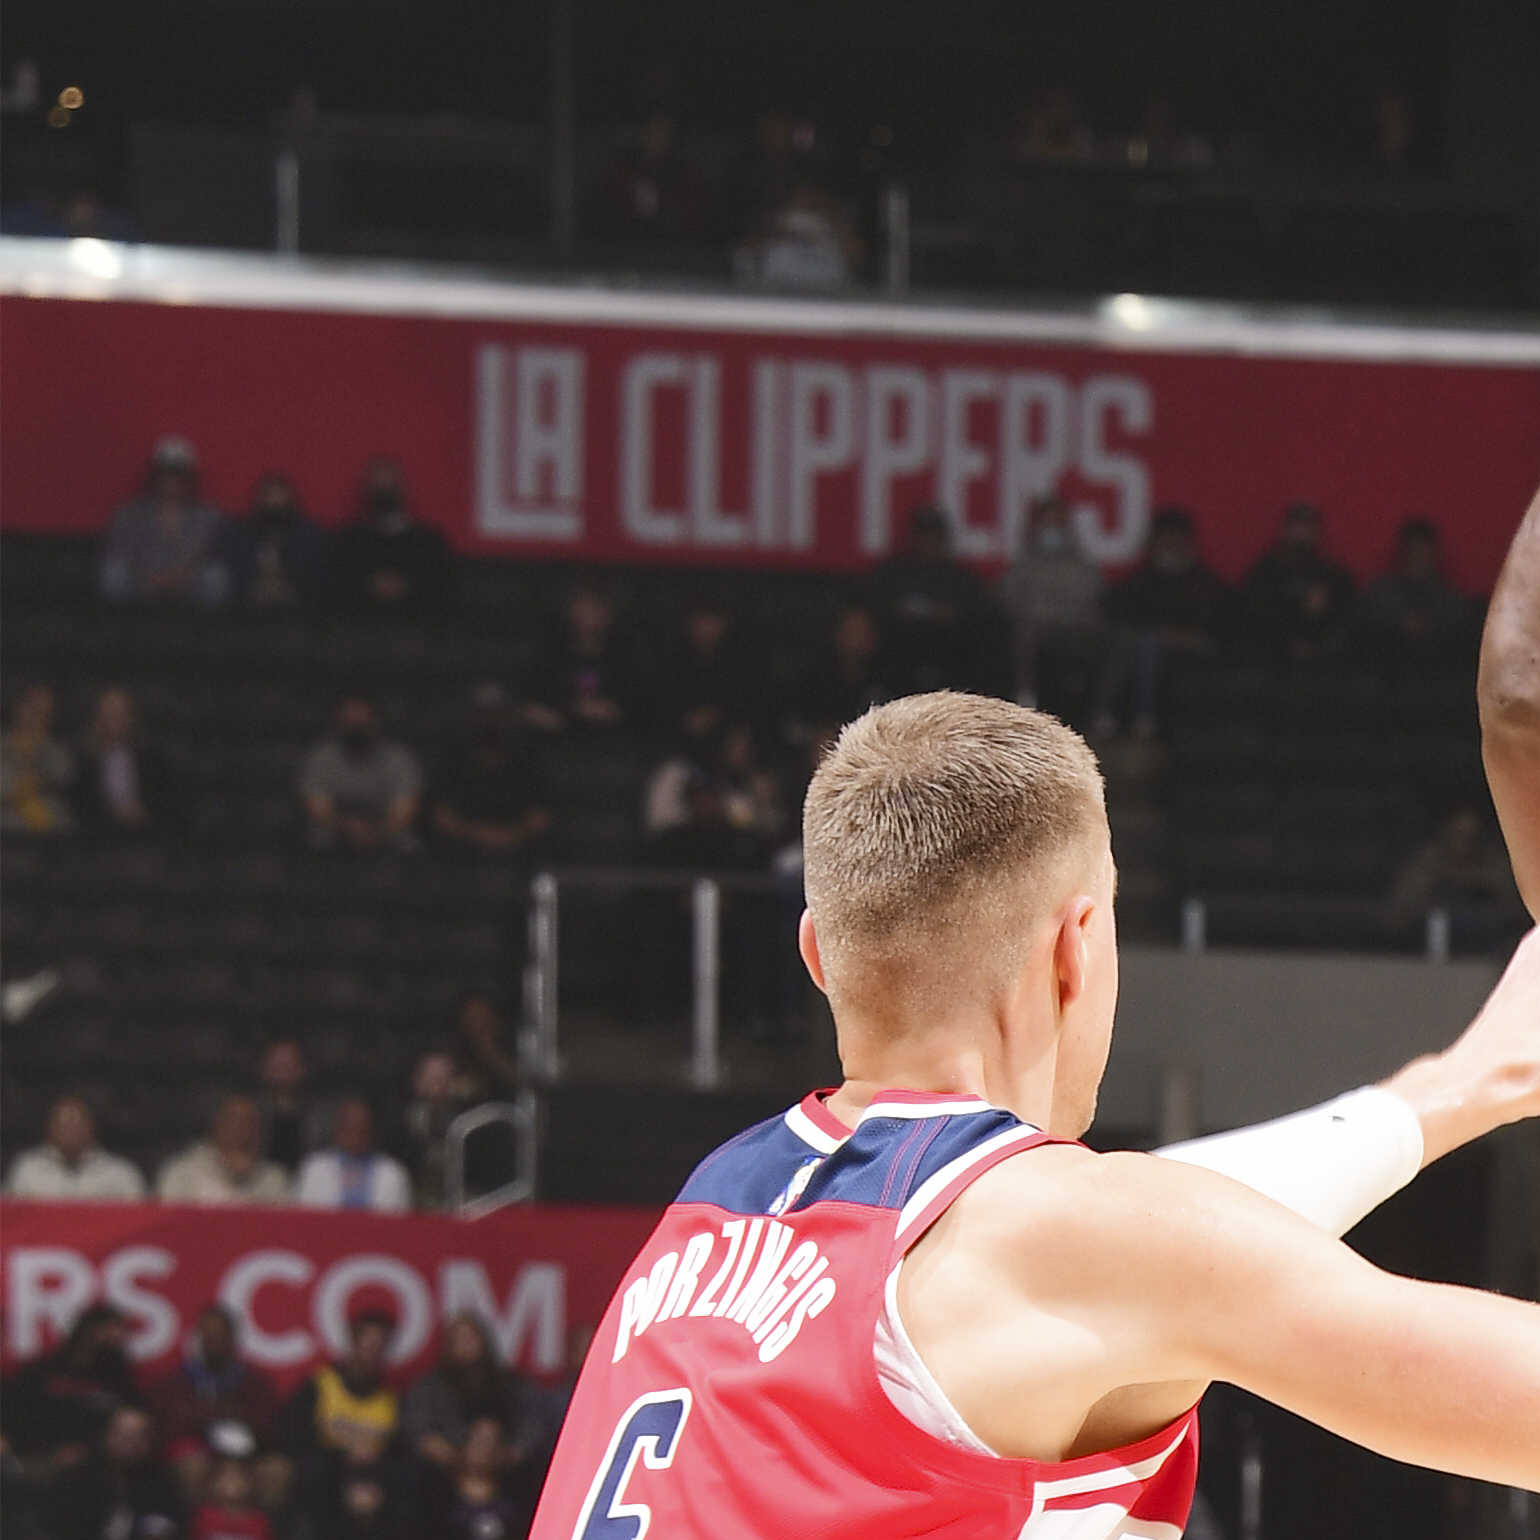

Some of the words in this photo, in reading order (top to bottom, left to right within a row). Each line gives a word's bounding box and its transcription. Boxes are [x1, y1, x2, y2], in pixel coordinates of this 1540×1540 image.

[476, 345, 586, 540] LA
[621, 355, 1152, 562] CLIPPERS
[612, 1218, 836, 1363] PORZINGIS
